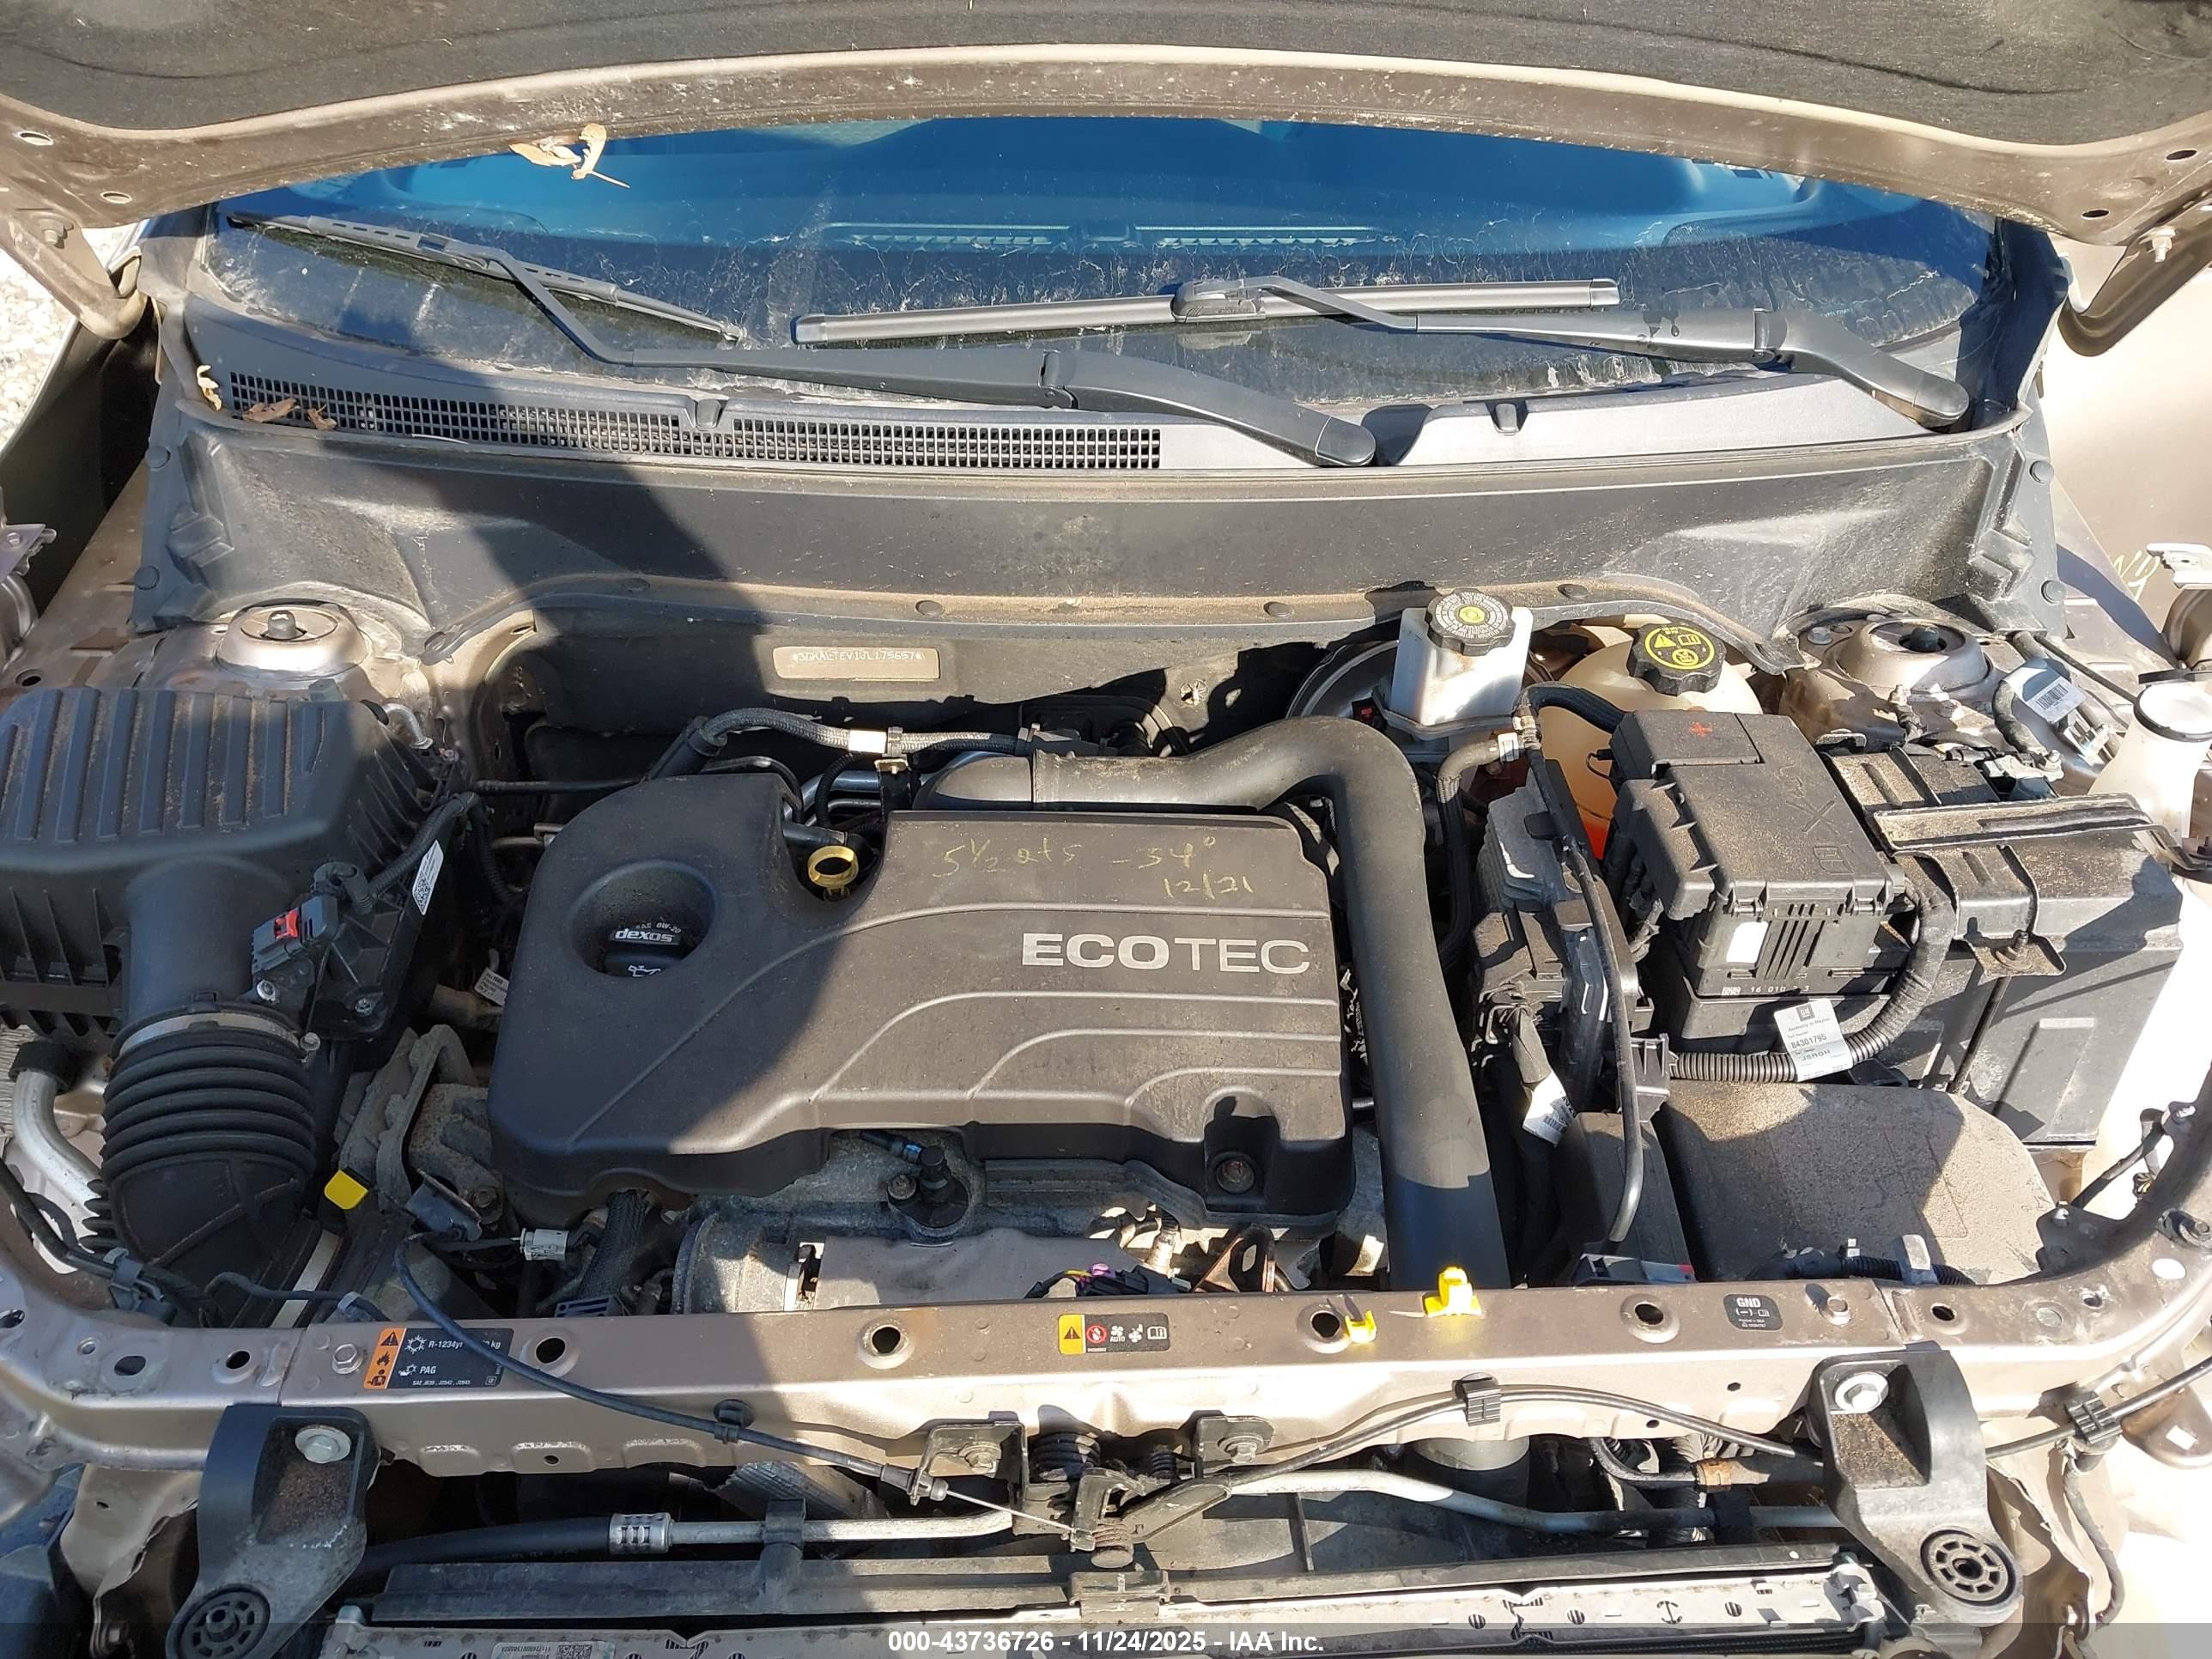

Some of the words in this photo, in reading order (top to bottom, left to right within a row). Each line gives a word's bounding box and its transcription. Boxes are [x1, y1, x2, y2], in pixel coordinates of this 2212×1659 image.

[615, 928, 675, 943] dexos
[1022, 933, 1310, 975] ECOTEC
[1736, 1297, 1761, 1307] GND
[490, 1340, 501, 1350] kg
[419, 1365, 437, 1375] PAG
